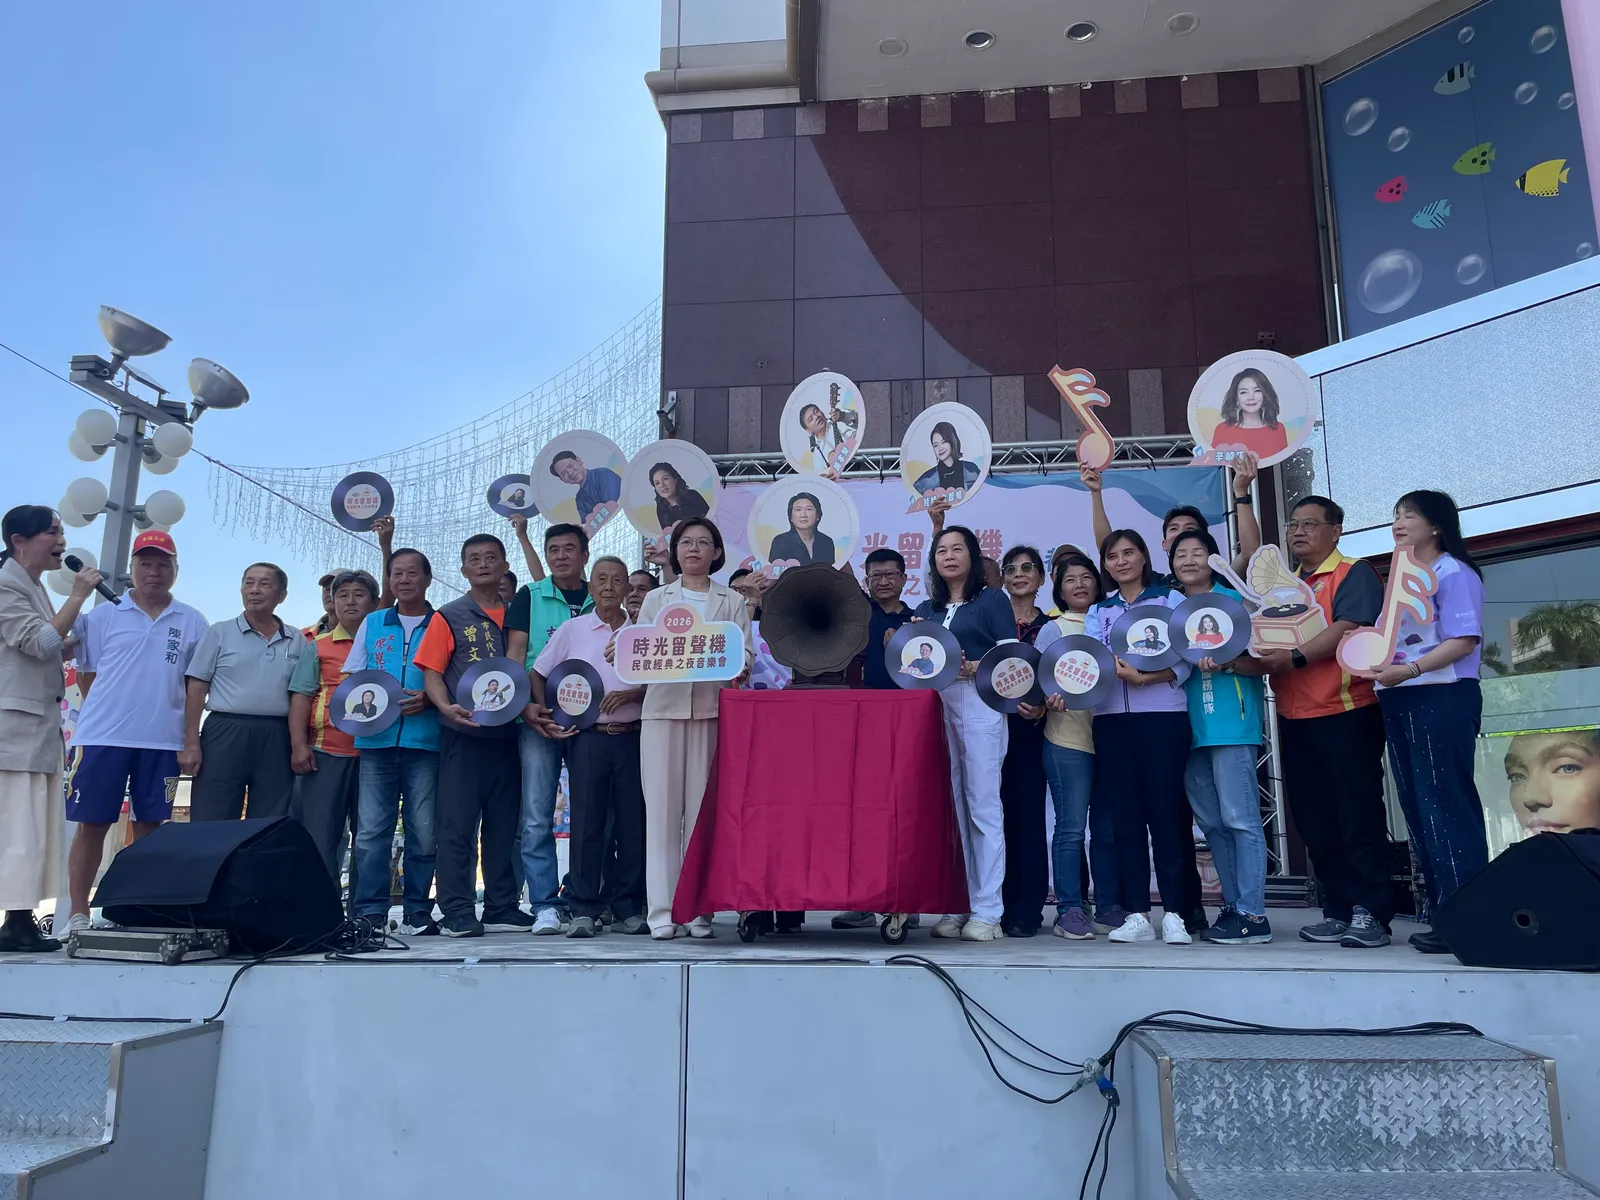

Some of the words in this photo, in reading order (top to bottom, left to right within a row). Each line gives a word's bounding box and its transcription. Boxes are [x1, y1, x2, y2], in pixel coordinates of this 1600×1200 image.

[666, 616, 692, 627] 2026
[165, 626, 182, 665] 陳家和
[632, 633, 727, 658] 時光留聲機
[631, 655, 728, 672] 民歌經典之夜音樂會
